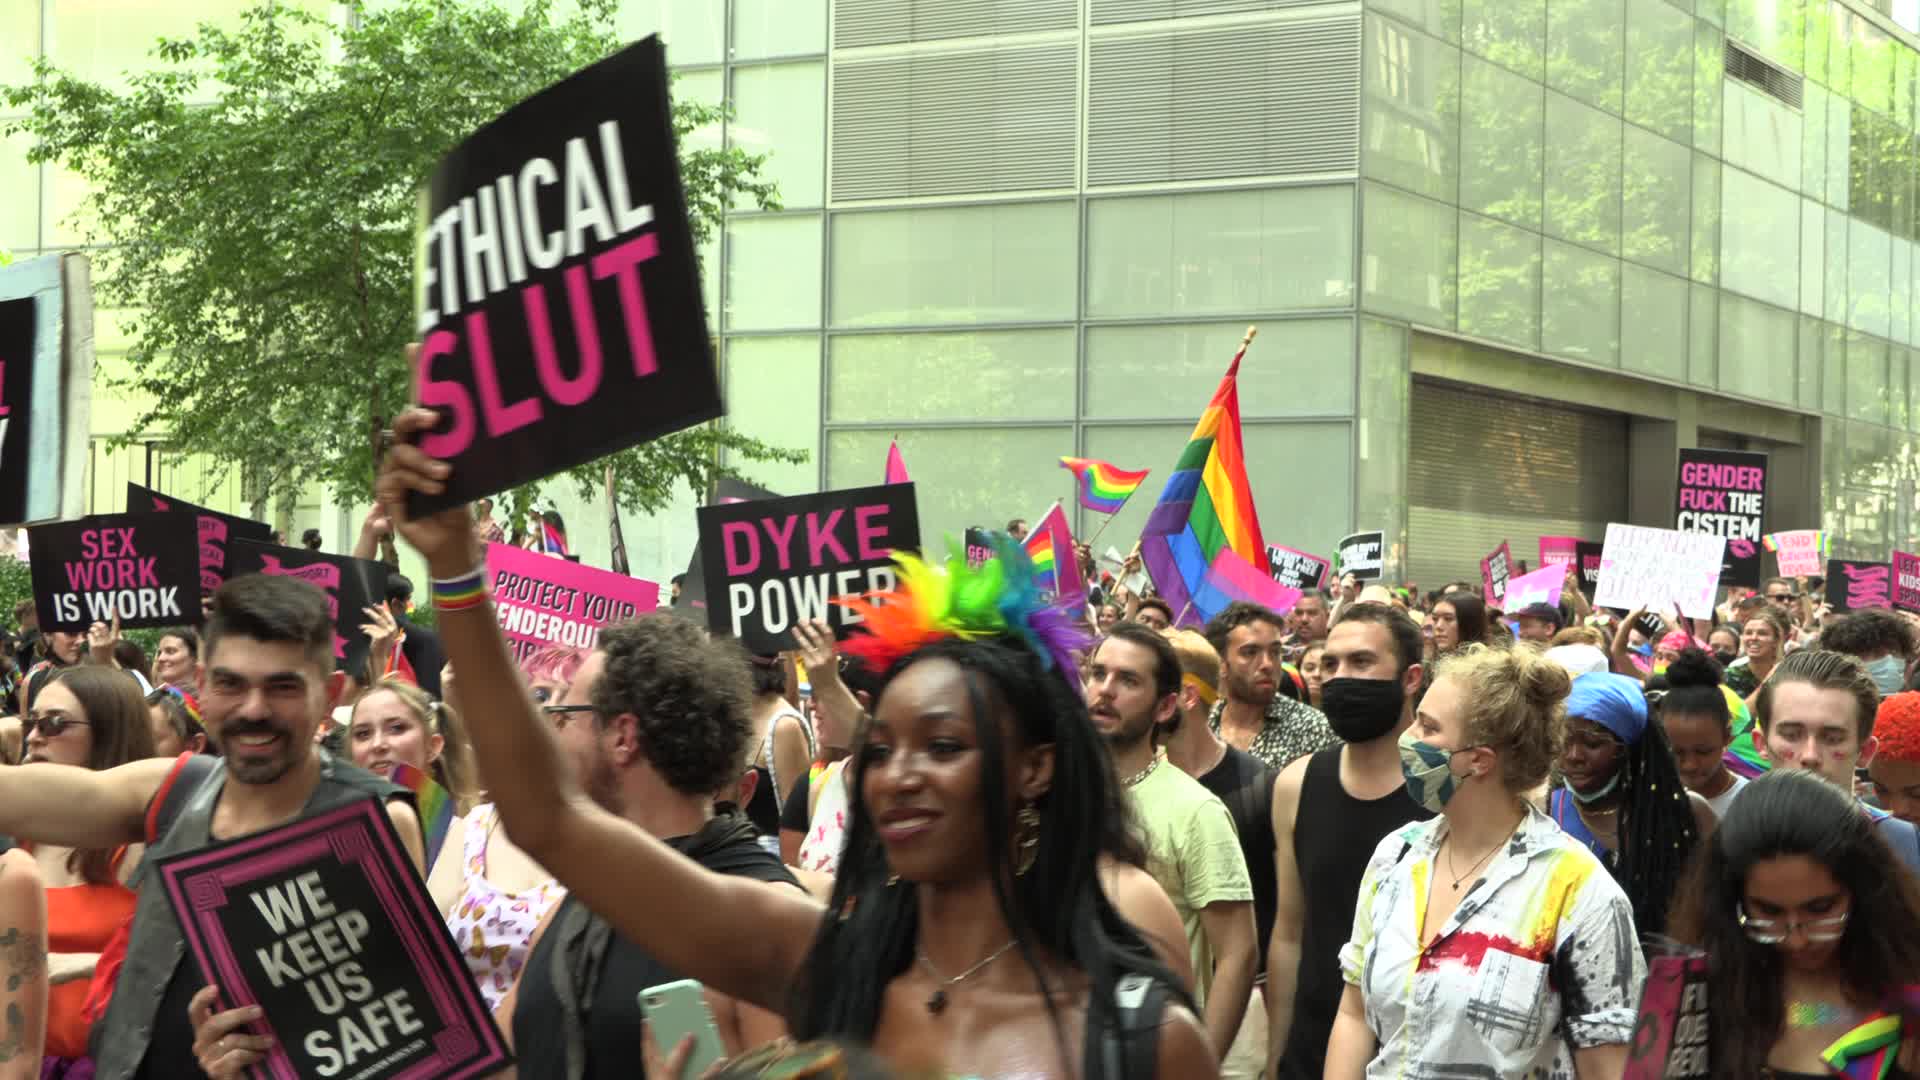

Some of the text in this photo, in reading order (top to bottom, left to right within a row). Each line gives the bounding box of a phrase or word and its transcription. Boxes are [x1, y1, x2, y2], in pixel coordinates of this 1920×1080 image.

[418, 119, 656, 333] ETHICAL
[419, 231, 661, 459] SLUT
[1681, 462, 1764, 491] GENDER
[1679, 488, 1763, 515] FUCK THE
[81, 527, 137, 560] SEX
[721, 504, 892, 576] DYKE
[1677, 511, 1761, 543] CISTEM
[64, 556, 160, 592] WORK
[494, 570, 581, 615] PROTECT
[1898, 572, 1920, 592] KIDS
[53, 586, 182, 623] IS WORK
[250, 870, 336, 936] WE
[255, 909, 371, 988] KEEP
[303, 961, 375, 1015] US
[303, 988, 425, 1078] SAFE
